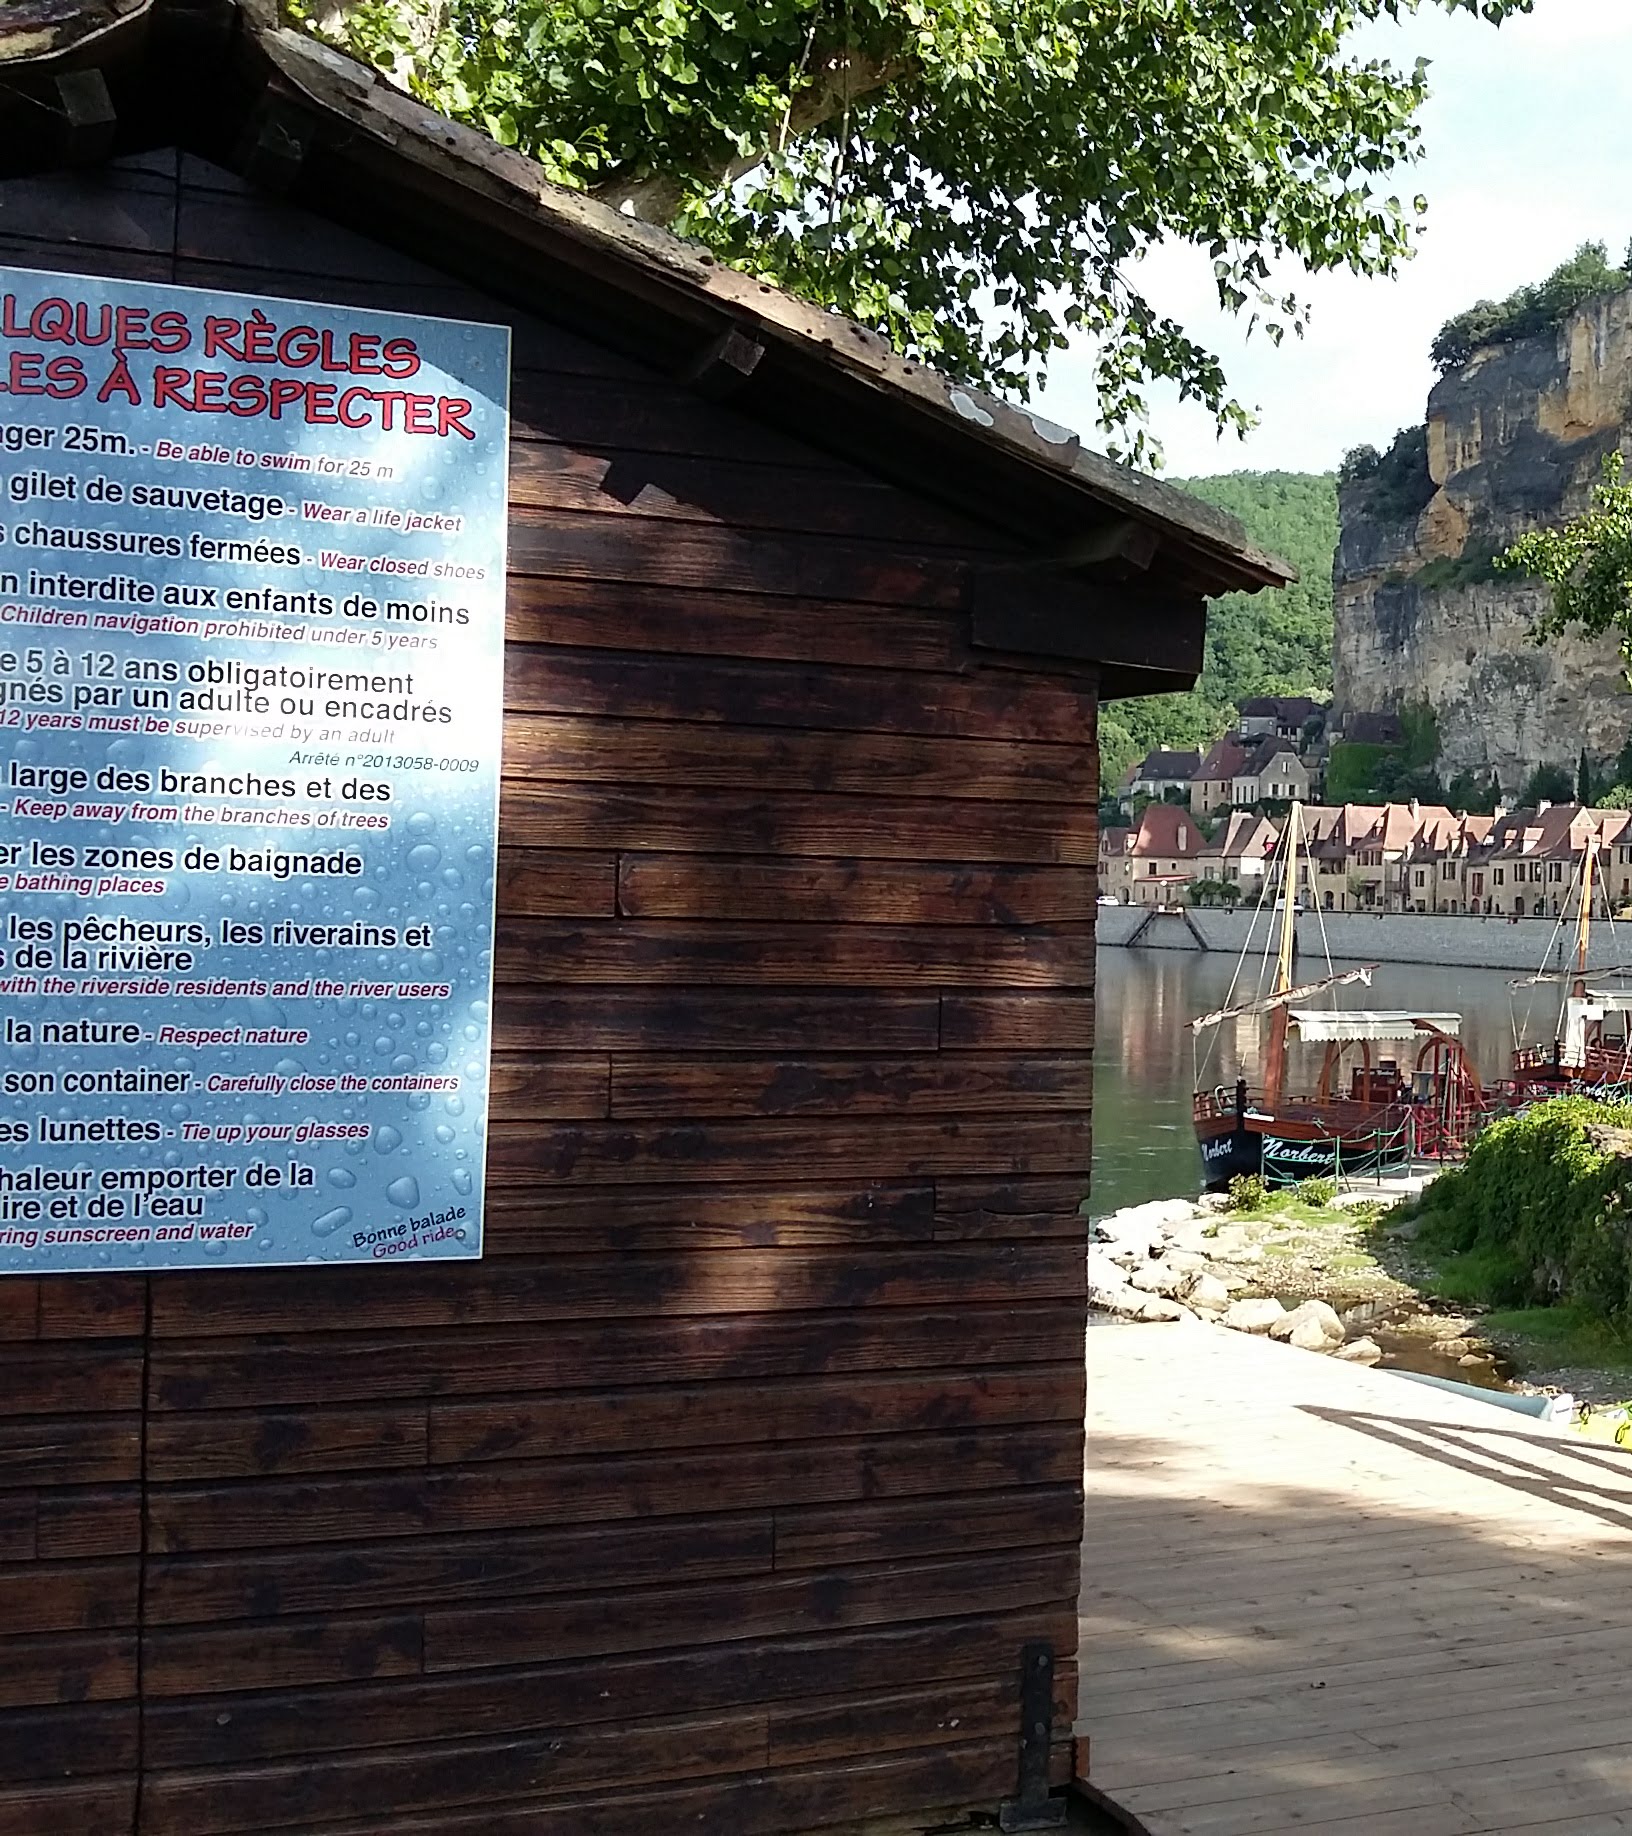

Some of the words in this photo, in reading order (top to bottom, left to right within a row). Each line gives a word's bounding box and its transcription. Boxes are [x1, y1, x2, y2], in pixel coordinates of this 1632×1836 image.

[204, 308, 421, 379] RÈGLES
[0, 351, 88, 399] ES
[98, 350, 140, 404] À
[153, 365, 476, 442] RESPECTER
[0, 426, 55, 450] ger
[157, 442, 182, 458] Be
[189, 445, 232, 463] able
[237, 447, 256, 465] to
[261, 450, 310, 474] swim
[318, 457, 344, 473] for
[349, 461, 371, 476] 25
[377, 467, 393, 478] m
[11, 472, 76, 502] gilet
[86, 478, 122, 502] de
[132, 487, 283, 520] sauvetage
[304, 503, 351, 523] Wear
[356, 512, 366, 522] a
[373, 510, 400, 526] life
[405, 513, 461, 535] jacket
[15, 522, 180, 556] chaussures
[190, 534, 300, 565] fermées
[320, 552, 370, 574] Wear
[370, 557, 429, 580] closed
[434, 563, 485, 579] shoes
[30, 571, 154, 604] interdite
[164, 585, 219, 607] aux
[227, 588, 332, 618] enfants
[344, 595, 377, 618] de
[387, 601, 469, 624] moins
[2, 605, 87, 631] Children
[94, 612, 198, 637] navigation
[204, 621, 305, 644] prohibited
[312, 629, 366, 644] under
[372, 631, 382, 645] 5
[388, 635, 437, 650] years
[27, 650, 42, 673] 5
[54, 650, 69, 674] à
[82, 653, 114, 677] 12
[125, 659, 178, 681] ans
[188, 660, 413, 694] obligatoirement
[74, 686, 124, 711] par
[134, 690, 168, 708] un
[180, 688, 269, 713] adulte
[281, 698, 313, 715] ou
[326, 699, 451, 723] encadrés
[22, 710, 81, 736] years
[88, 713, 143, 735] must
[145, 716, 169, 732] be
[290, 725, 312, 743] by
[319, 730, 341, 740] an
[348, 729, 394, 743] adult
[288, 751, 340, 765] Arrêté
[12, 762, 87, 796] large
[97, 767, 149, 791] des
[162, 769, 295, 798] branches
[307, 778, 331, 798] et
[342, 778, 390, 801] des
[12, 797, 67, 820] Keep
[73, 801, 125, 824] away
[132, 798, 177, 820] from
[185, 806, 214, 821] the
[221, 807, 310, 825] branches
[318, 811, 339, 825] of
[342, 813, 391, 834] trees
[33, 842, 74, 866] les
[85, 849, 173, 869] zones
[185, 847, 219, 870] de
[230, 848, 361, 880] baignade
[16, 871, 92, 896] bathing
[98, 876, 164, 898] places
[11, 916, 52, 940] les
[223, 920, 262, 943] les
[272, 917, 396, 949] riverains
[402, 922, 430, 946] et
[16, 945, 52, 968] de
[62, 951, 86, 969] la
[99, 944, 192, 970] rivière
[44, 978, 75, 993] the
[82, 975, 169, 994] riverside
[176, 976, 266, 999] residents
[272, 979, 309, 995] and
[315, 980, 345, 996] the
[350, 980, 394, 1002] river
[398, 981, 449, 996] users
[7, 1019, 31, 1042] la
[44, 1019, 139, 1043] nature
[160, 1026, 240, 1047] Respect
[246, 1028, 307, 1043] nature
[5, 1074, 53, 1092] son
[64, 1066, 191, 1092] container
[208, 1072, 287, 1095] Carefully
[289, 1074, 335, 1094] close
[341, 1074, 367, 1090] the
[372, 1076, 458, 1090] containers
[41, 1115, 160, 1141] lunettes
[180, 1124, 210, 1139] Tie
[215, 1122, 241, 1144] up
[246, 1122, 292, 1145] your
[295, 1121, 369, 1144] glasses
[1201, 1138, 1233, 1162] Norbert
[1262, 1138, 1336, 1165] Norbert
[102, 1164, 236, 1195] emporter
[246, 1161, 280, 1186] de
[291, 1163, 312, 1185] la
[50, 1196, 77, 1218] et
[88, 1194, 124, 1217] de
[44, 1226, 150, 1245] sunscreen
[156, 1224, 194, 1240] and
[201, 1219, 254, 1239] water
[353, 1225, 407, 1251] Bonne
[410, 1207, 466, 1231] balade
[373, 1234, 418, 1258] Good
[422, 1226, 455, 1244] ride
